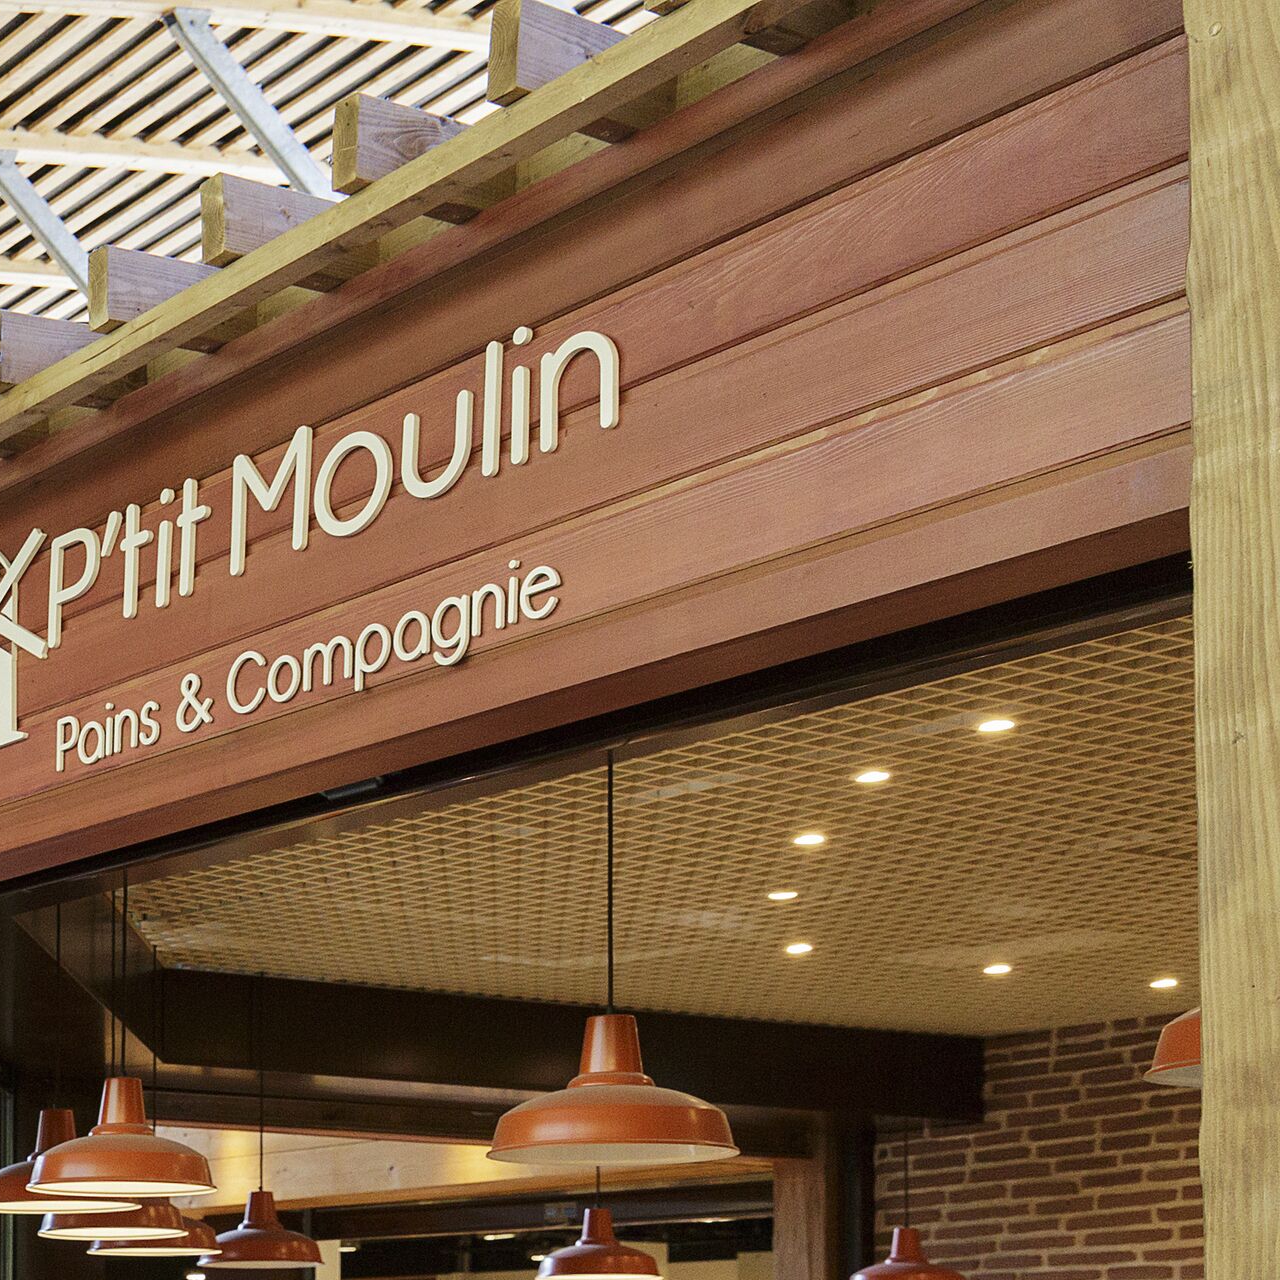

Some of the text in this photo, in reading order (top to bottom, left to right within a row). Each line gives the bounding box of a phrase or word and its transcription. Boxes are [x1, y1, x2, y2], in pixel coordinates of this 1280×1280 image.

[46, 326, 621, 649] P'tit Moulin
[56, 559, 562, 772] Pains & Compagnie
